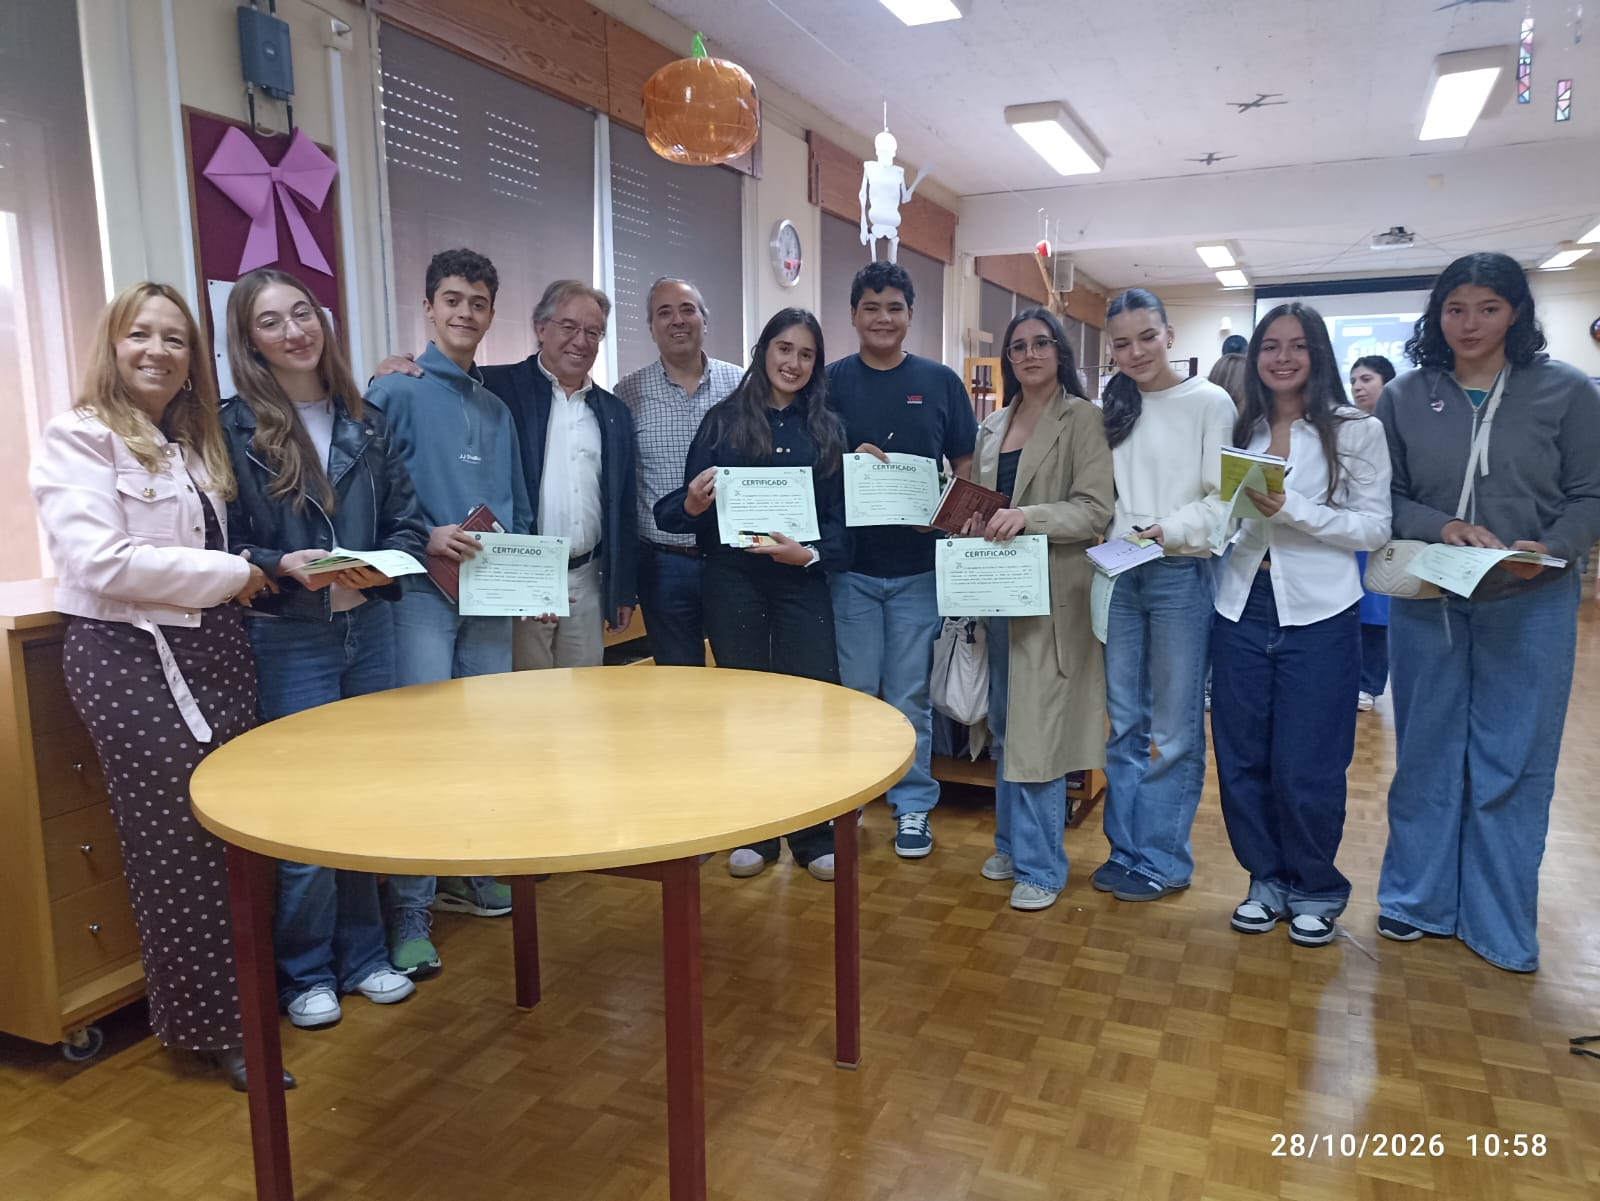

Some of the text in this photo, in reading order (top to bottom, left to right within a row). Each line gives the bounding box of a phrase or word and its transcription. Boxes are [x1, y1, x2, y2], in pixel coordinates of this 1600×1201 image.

[872, 464, 917, 472] CERTIFICADO
[492, 546, 542, 556] CERTIFICADO
[965, 549, 1017, 558] CERTIFICADO
